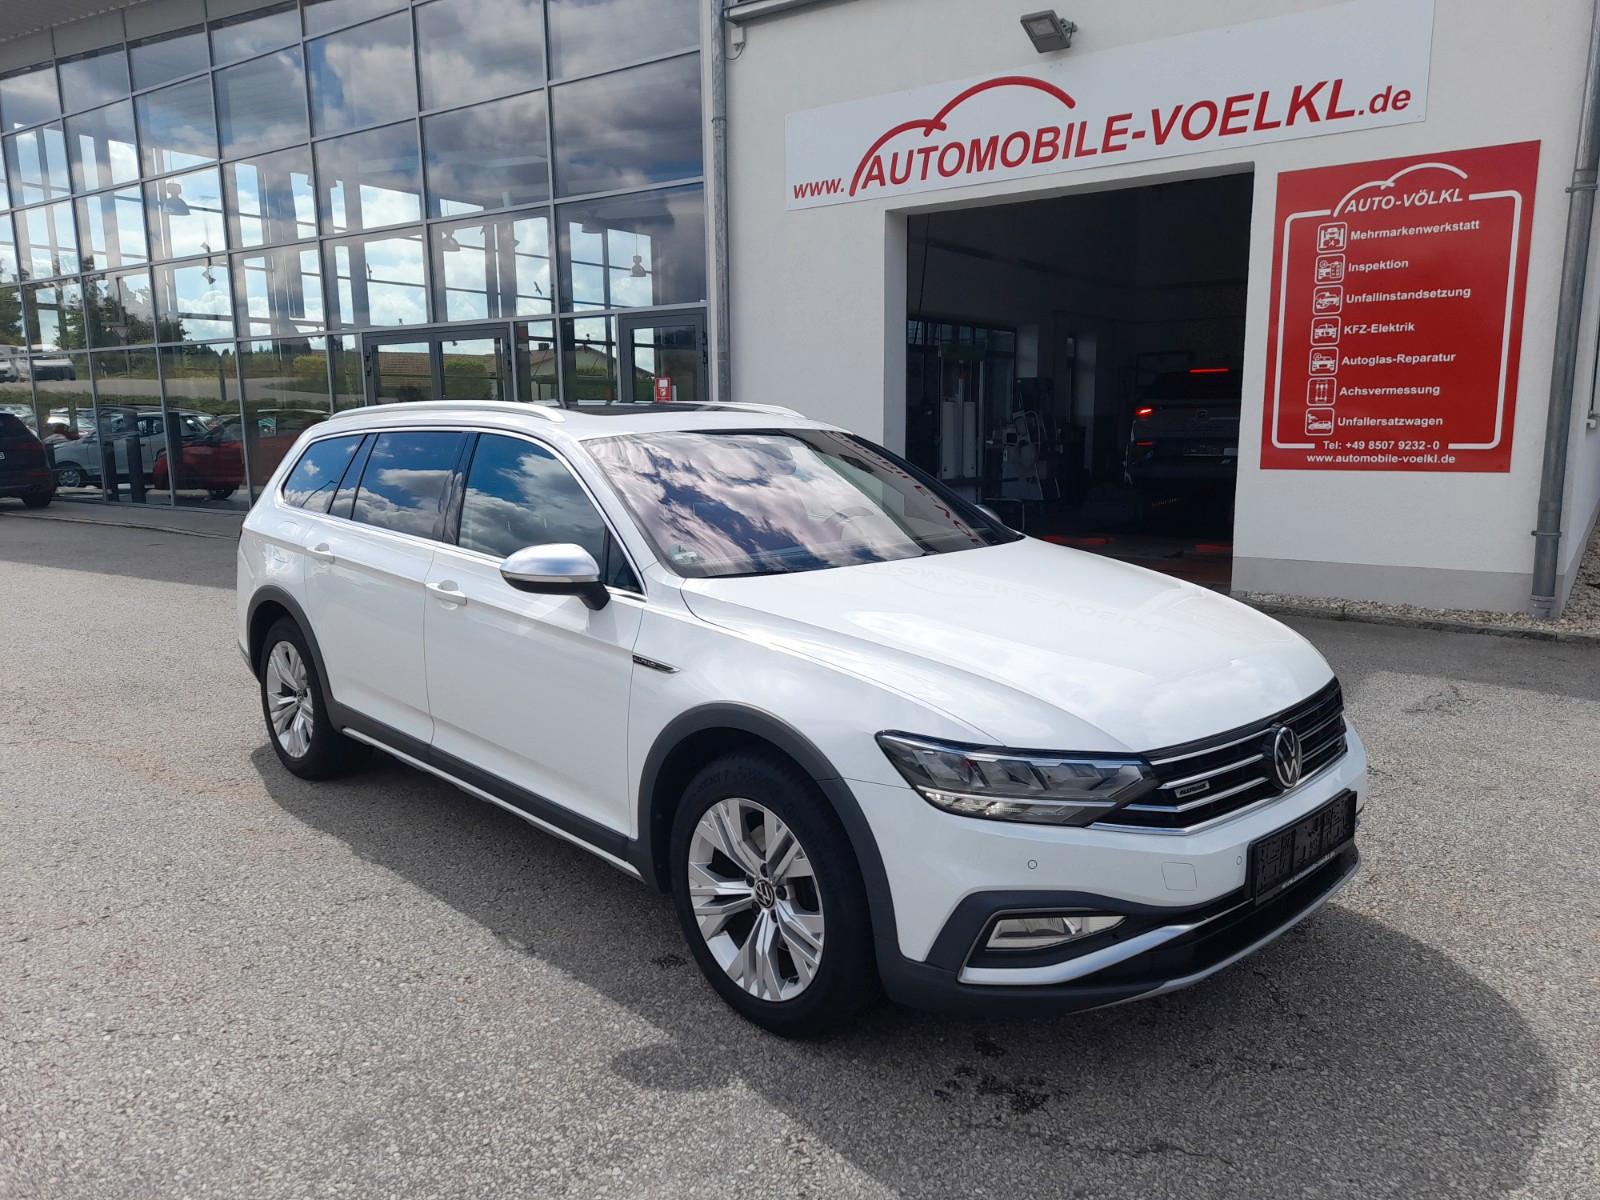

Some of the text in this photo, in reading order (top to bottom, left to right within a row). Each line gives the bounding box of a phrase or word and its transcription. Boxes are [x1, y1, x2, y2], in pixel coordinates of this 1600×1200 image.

[1344, 187, 1464, 214] AUTO-VÖLKL
[1350, 219, 1480, 241] Mehrmarkenwerkstatt
[1348, 259, 1409, 273] Inspektion
[1346, 286, 1471, 304] Unfallinstandsetzung
[1343, 321, 1415, 335] KFZ-Elektrik
[1341, 352, 1456, 367] Autoglas-Reparatur
[1339, 384, 1441, 397] Achsvermessung
[1337, 416, 1443, 429] Unfallersatzwagen
[1323, 439, 1342, 450] Tel:
[1345, 440, 1365, 450] +49
[1368, 439, 1395, 450] 8507
[1306, 453, 1456, 465] www.automobile-voelkl.de
